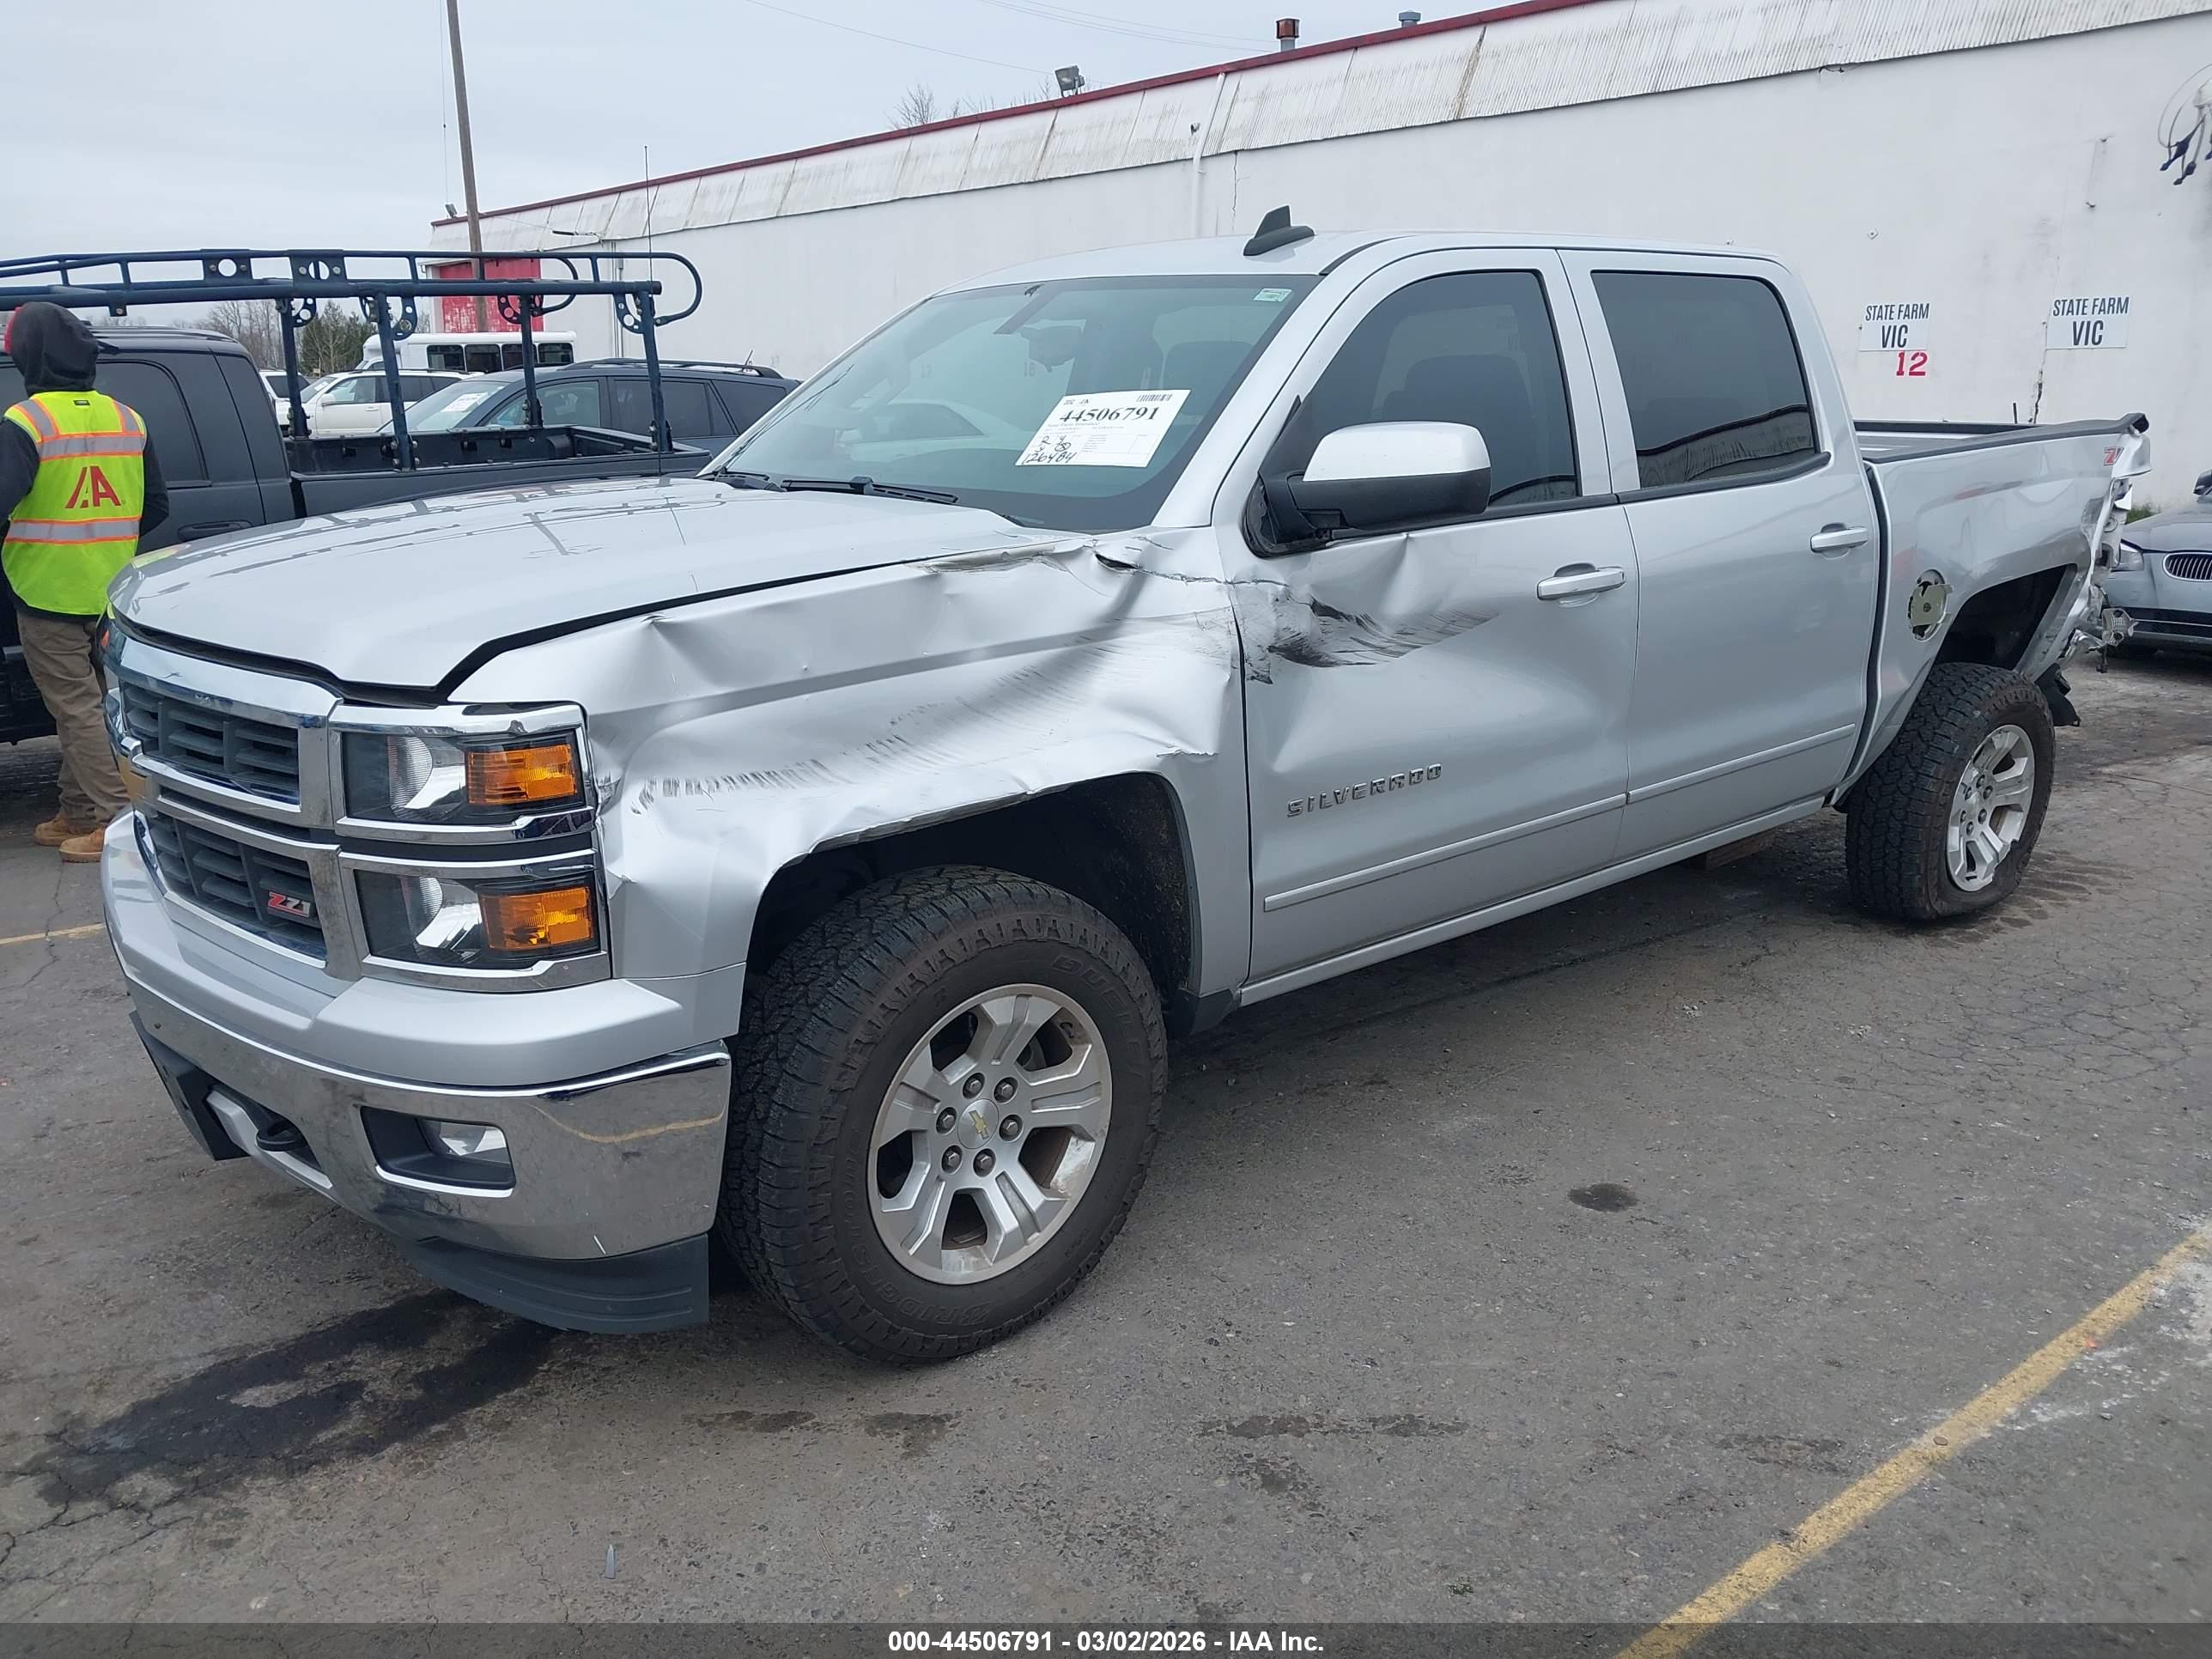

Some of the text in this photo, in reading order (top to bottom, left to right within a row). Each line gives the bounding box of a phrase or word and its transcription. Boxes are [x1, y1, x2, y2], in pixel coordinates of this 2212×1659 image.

[1865, 303, 1929, 321] STATE FARM
[2052, 296, 2130, 317] STATE FARM
[1881, 325, 1908, 349] VIC
[2072, 320, 2104, 346] VIC
[1896, 352, 1929, 376] 12
[1060, 406, 1159, 422] 44506791
[1287, 763, 1443, 817] SILVERADO
[267, 891, 311, 918] Z71
